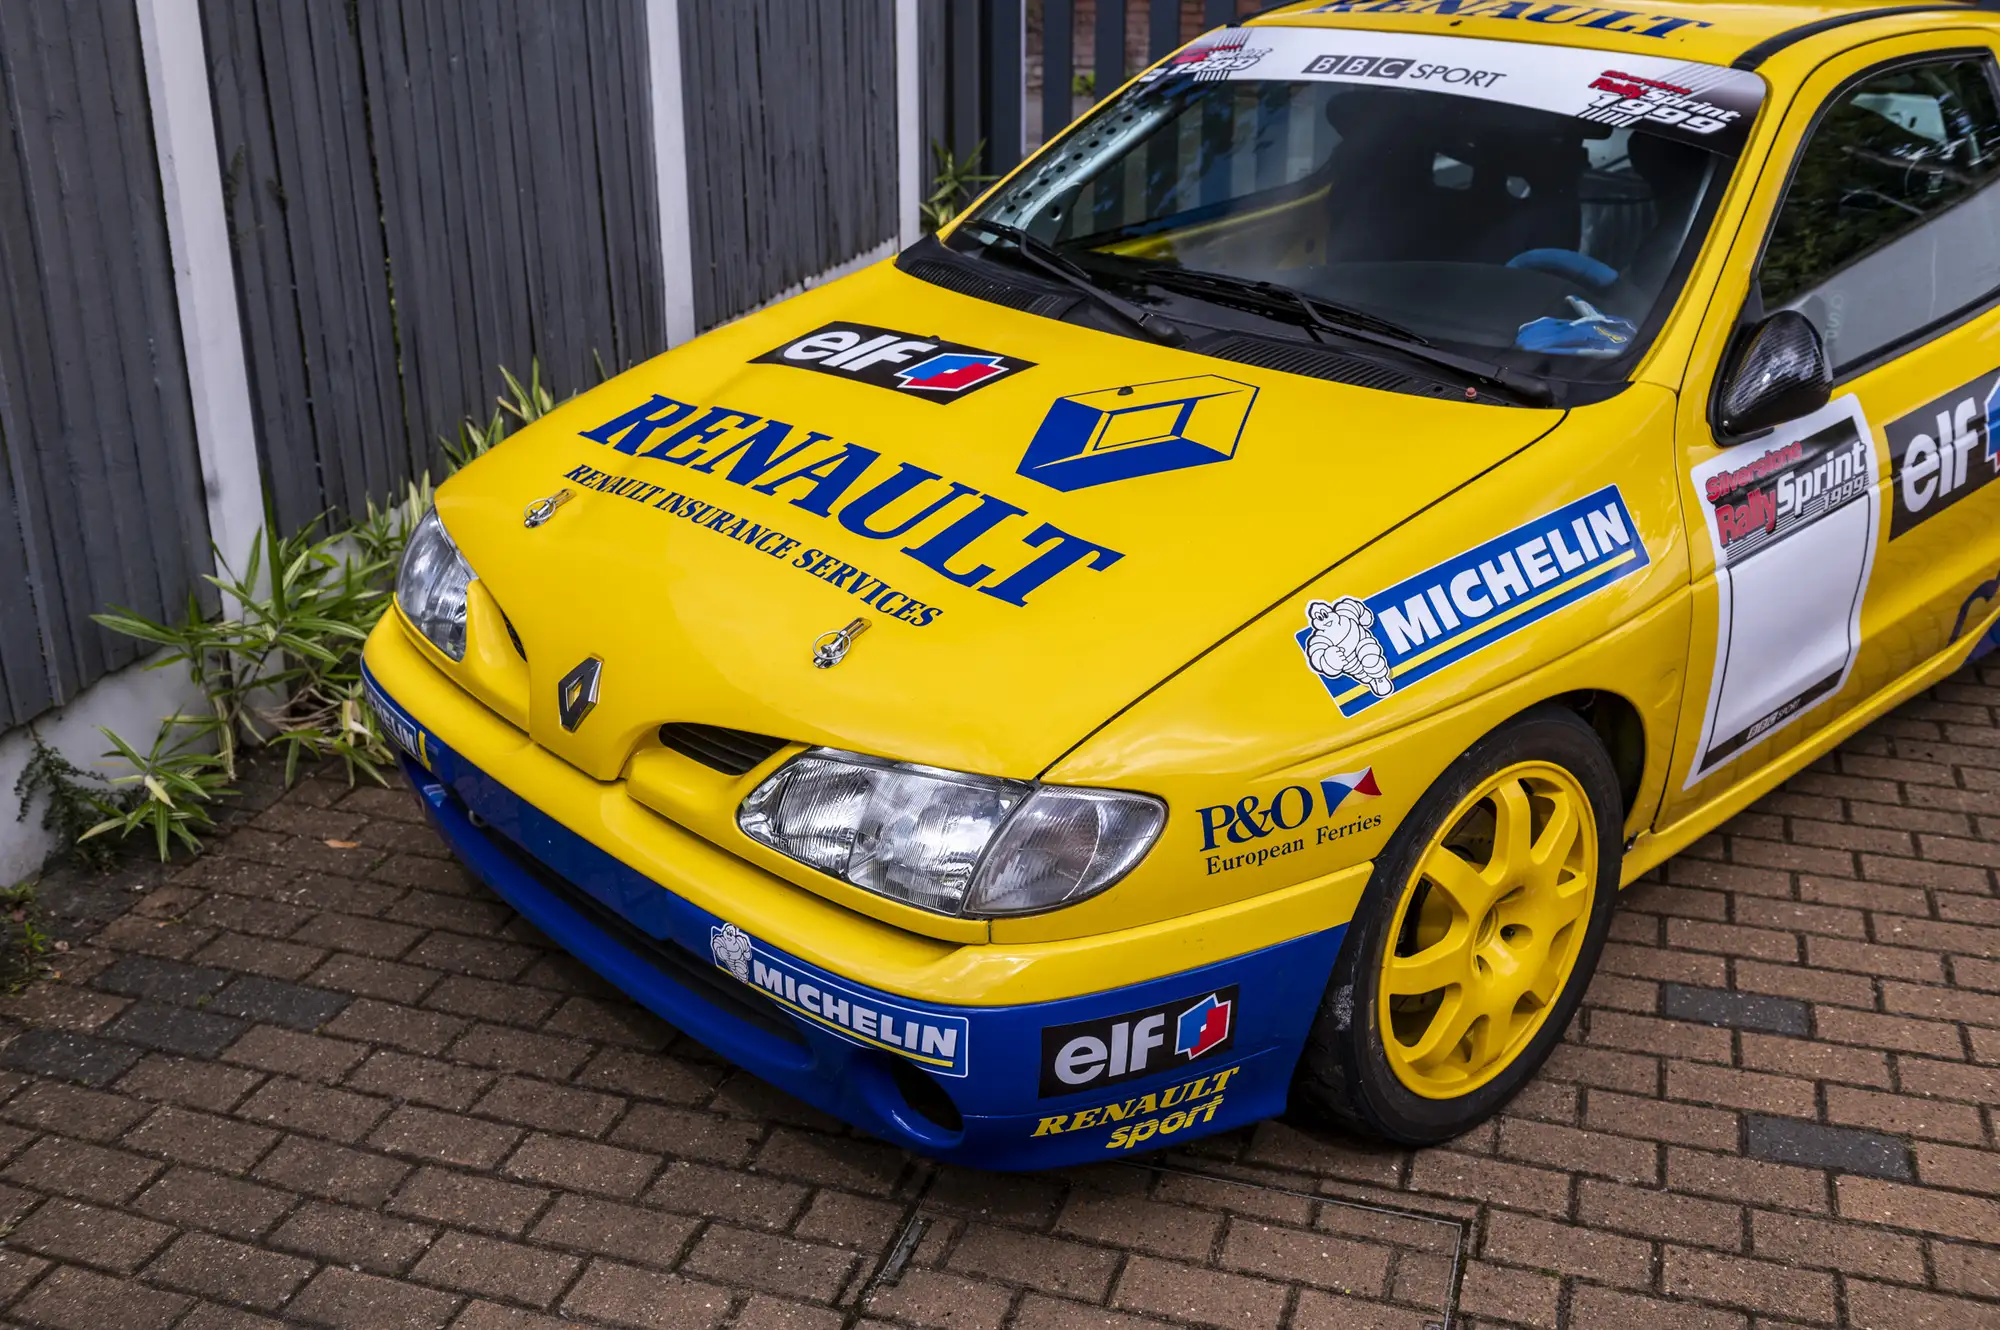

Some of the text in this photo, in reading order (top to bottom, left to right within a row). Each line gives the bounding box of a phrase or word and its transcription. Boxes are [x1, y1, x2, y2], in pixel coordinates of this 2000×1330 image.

[1308, 55, 1507, 89] BBC SPORT
[1589, 93, 1727, 134] 1999
[784, 329, 936, 372] elf
[1706, 441, 1803, 502] Silverstone
[1900, 396, 1979, 513] elf
[579, 394, 1126, 608] RENAULT
[1823, 475, 1865, 511] 1999
[563, 464, 944, 629] RENAULT INSURANCE SERVICES
[1376, 502, 1631, 655] MICHELIN
[1196, 785, 1314, 852] P&O
[1206, 812, 1383, 876] European Ferries
[753, 958, 959, 1057] MICHELIN
[1054, 1012, 1165, 1085] elf
[1031, 1066, 1240, 1138] RENAULT
[1105, 1095, 1224, 1150] sport
